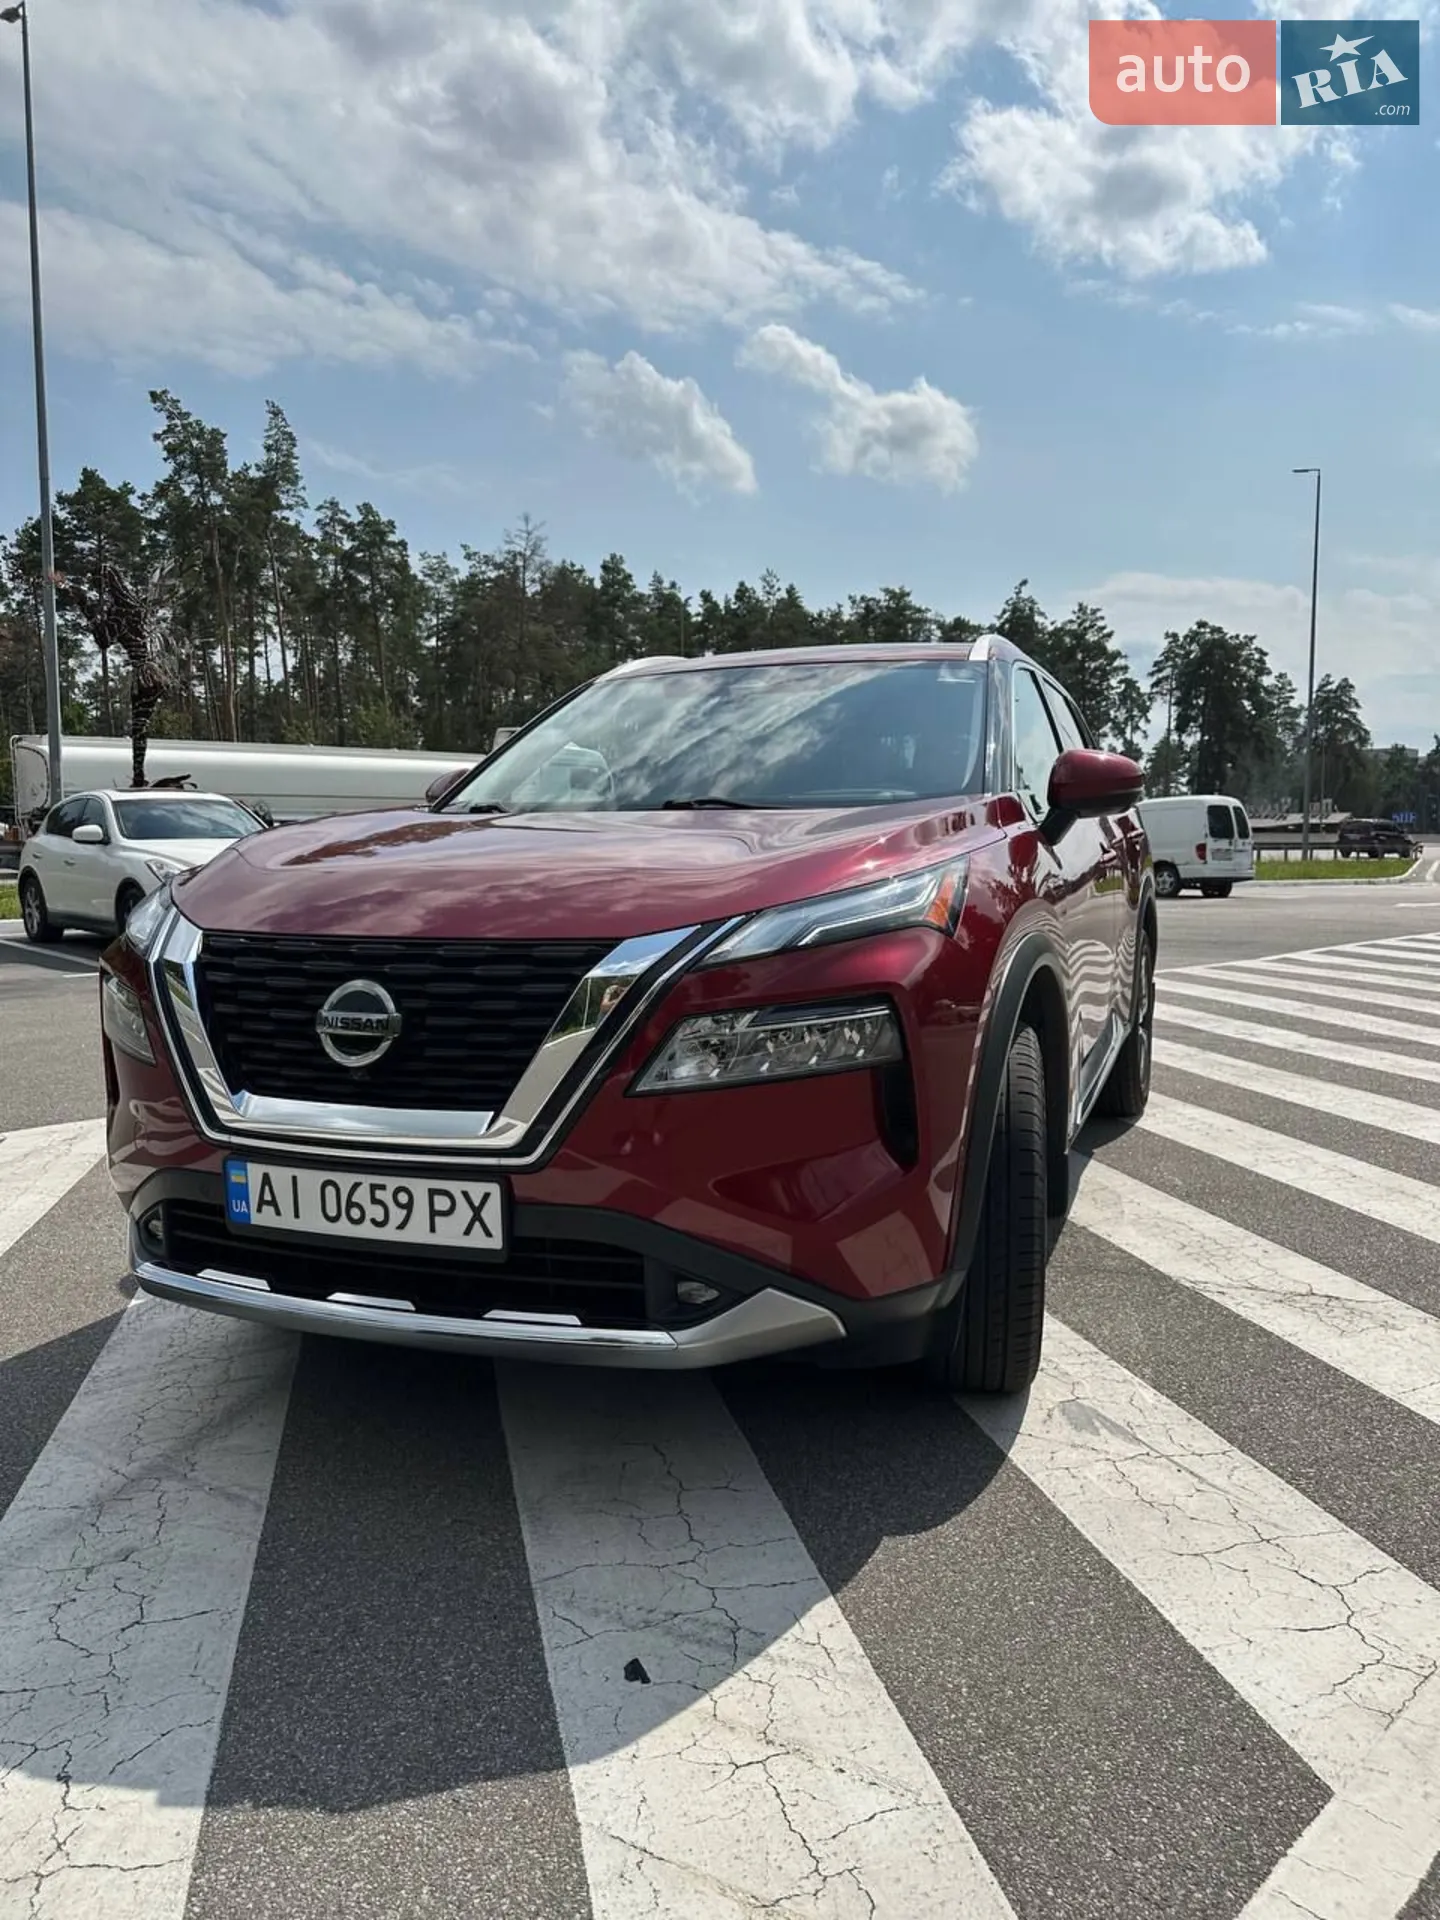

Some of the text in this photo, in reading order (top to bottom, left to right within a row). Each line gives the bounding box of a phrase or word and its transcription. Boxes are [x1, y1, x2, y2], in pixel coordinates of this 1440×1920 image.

[323, 1015, 390, 1032] NISSAN
[232, 1199, 249, 1213] UA
[256, 1171, 494, 1239] AI 0659 PX
